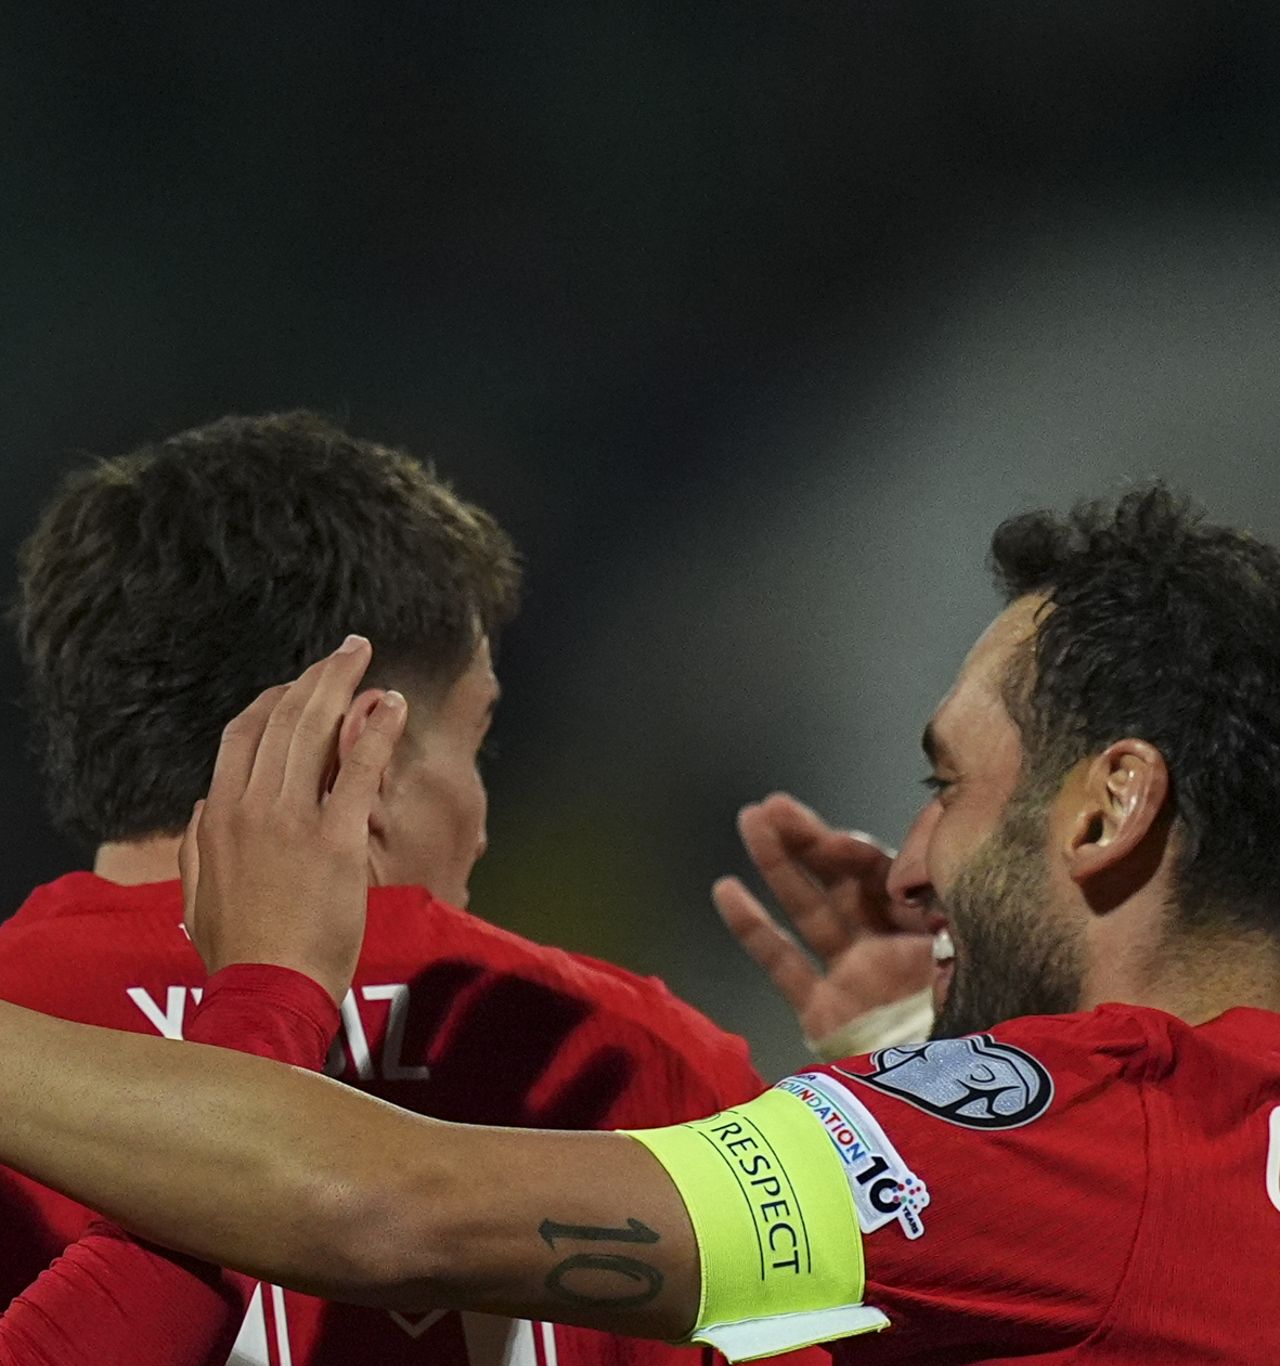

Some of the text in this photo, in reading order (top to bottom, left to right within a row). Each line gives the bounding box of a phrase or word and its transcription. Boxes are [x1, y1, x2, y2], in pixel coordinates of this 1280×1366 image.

[710, 1121, 801, 1275] RESPECT
[855, 1155, 904, 1214] 10
[538, 1217, 662, 1307] 10
